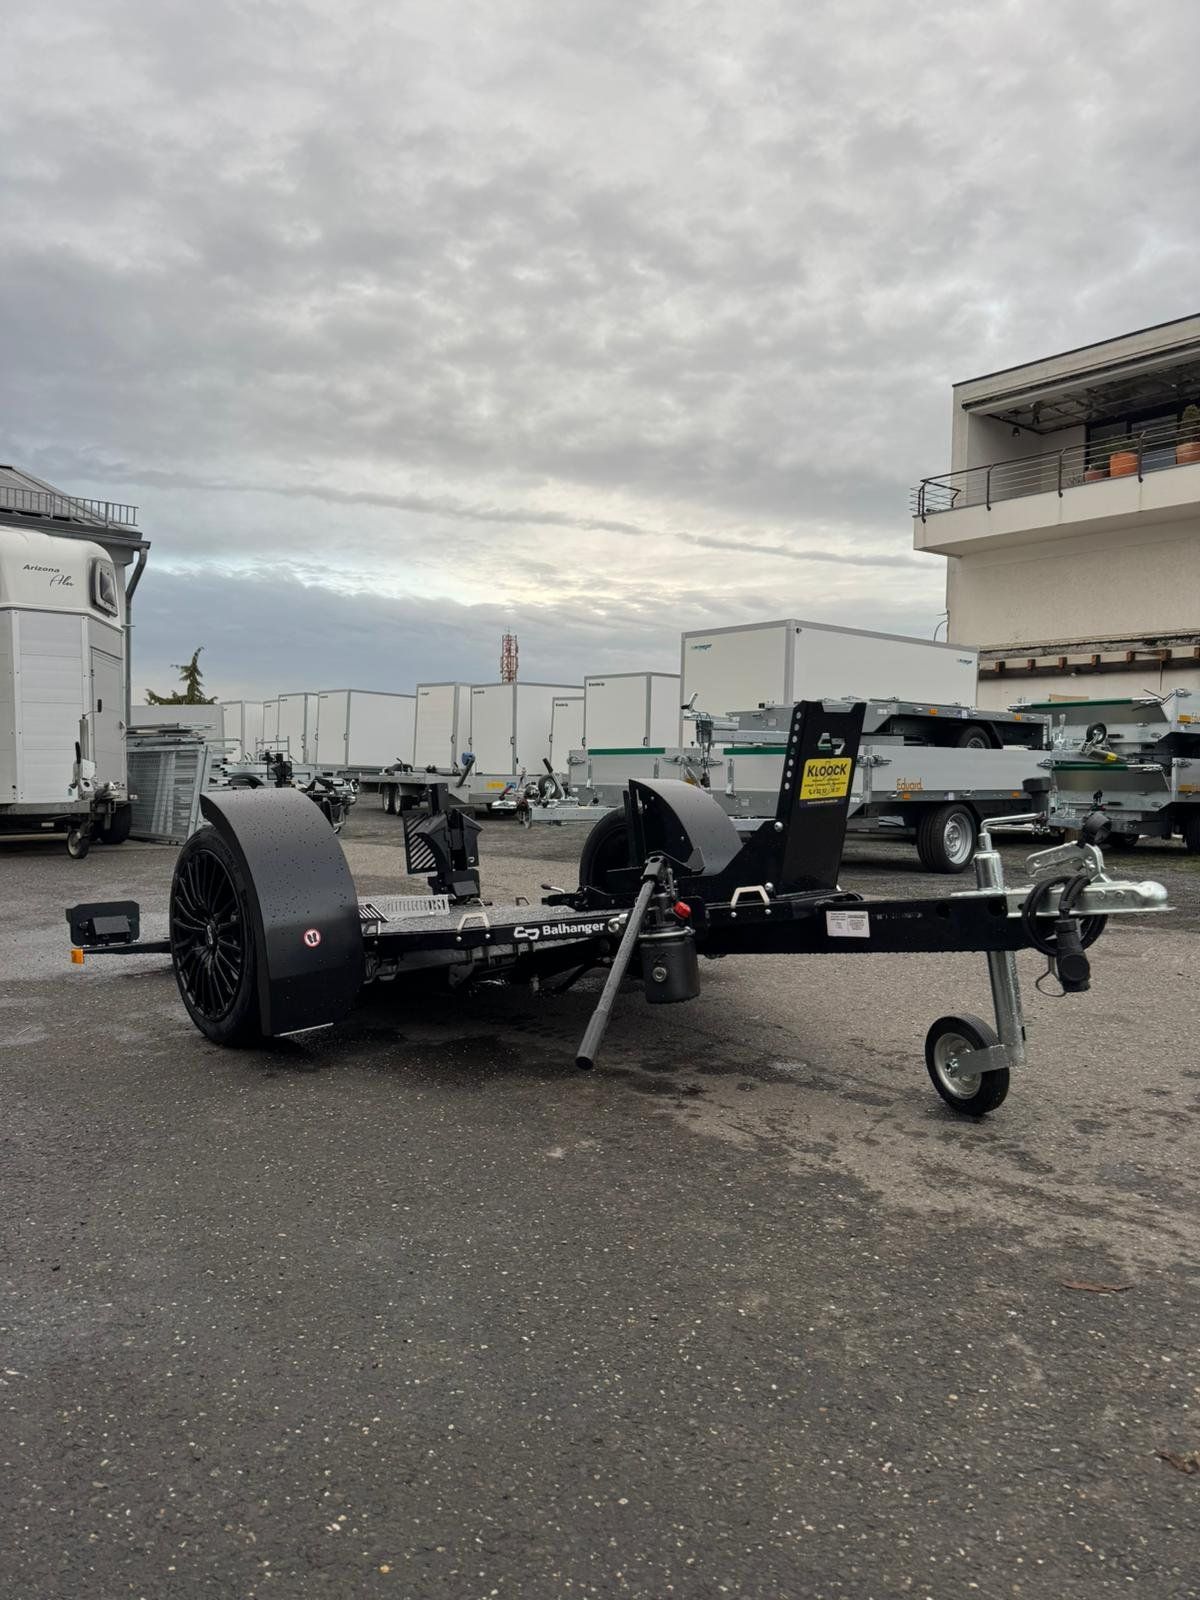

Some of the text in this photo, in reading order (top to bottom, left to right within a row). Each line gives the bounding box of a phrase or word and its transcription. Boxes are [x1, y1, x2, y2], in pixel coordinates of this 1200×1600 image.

[23, 563, 60, 573] Arizona
[807, 764, 847, 777] KLOOCK
[896, 777, 923, 790] Eduard
[543, 922, 605, 935] Balhanger
